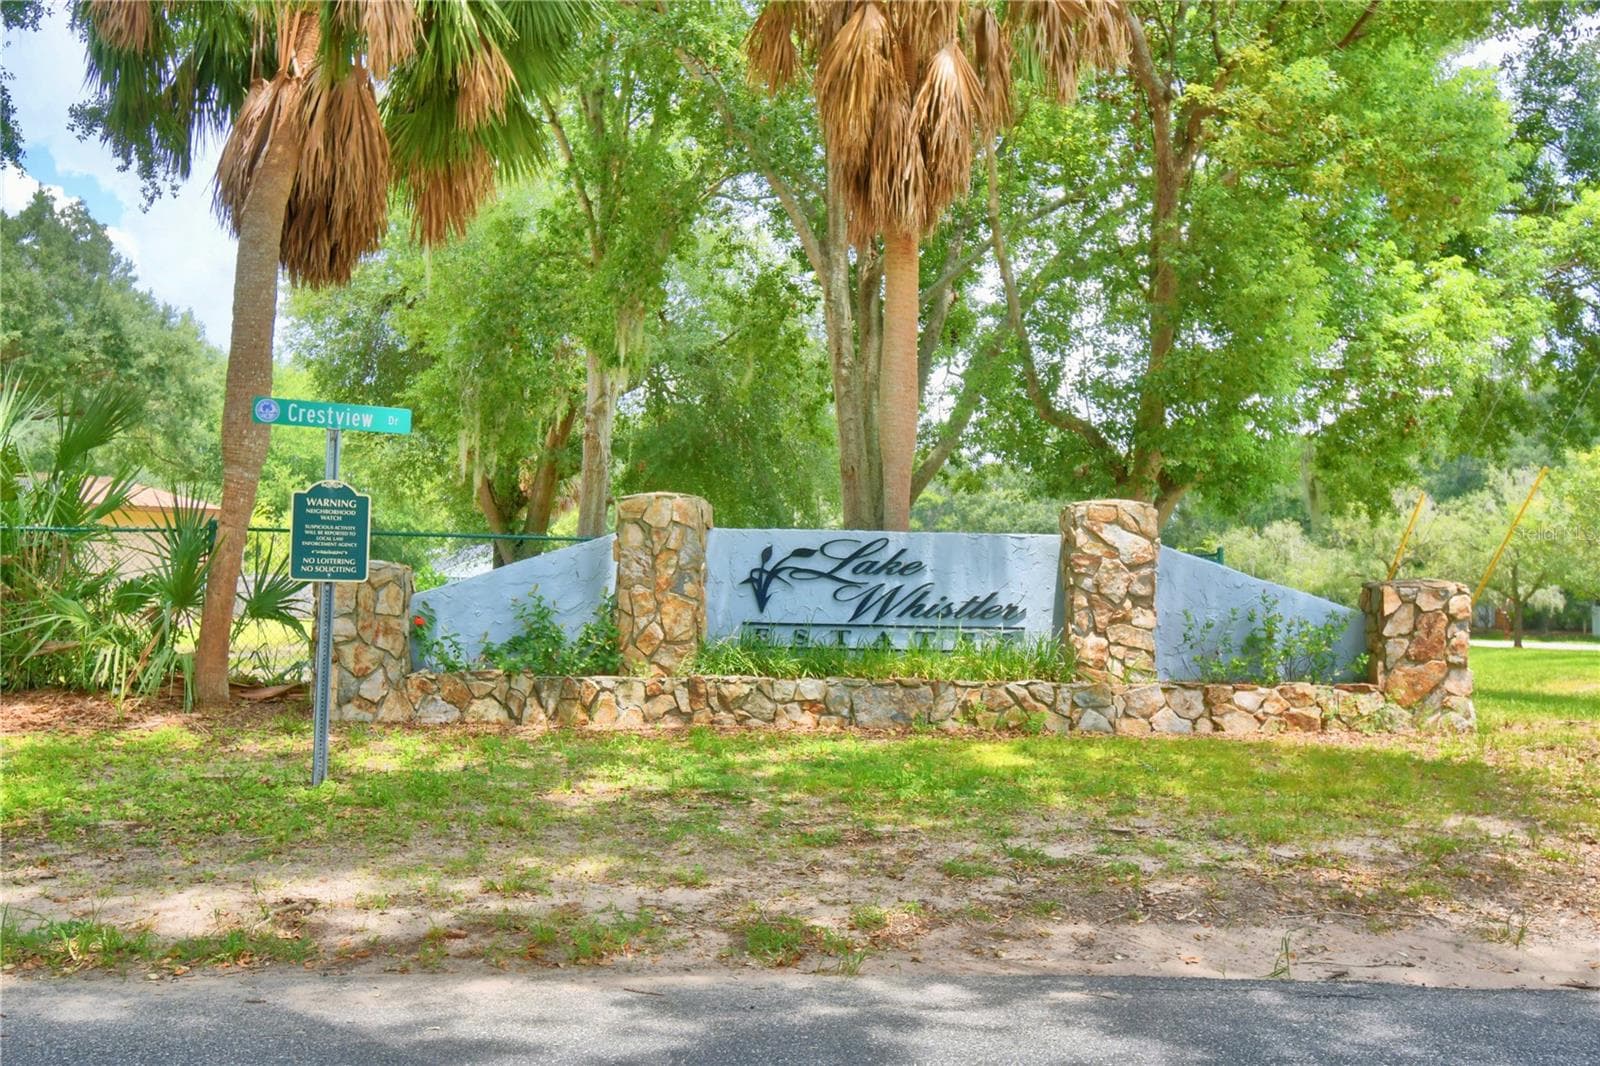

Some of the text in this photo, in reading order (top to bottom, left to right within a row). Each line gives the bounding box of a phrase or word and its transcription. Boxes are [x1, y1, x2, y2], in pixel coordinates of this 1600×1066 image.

[287, 403, 399, 428] Crestview Dr
[306, 497, 357, 508] WARNING
[305, 508, 356, 516] NEIGHBORHOOD
[316, 557, 356, 565] LOITERING
[790, 537, 926, 585] Lake
[833, 582, 1027, 623] Whistler
